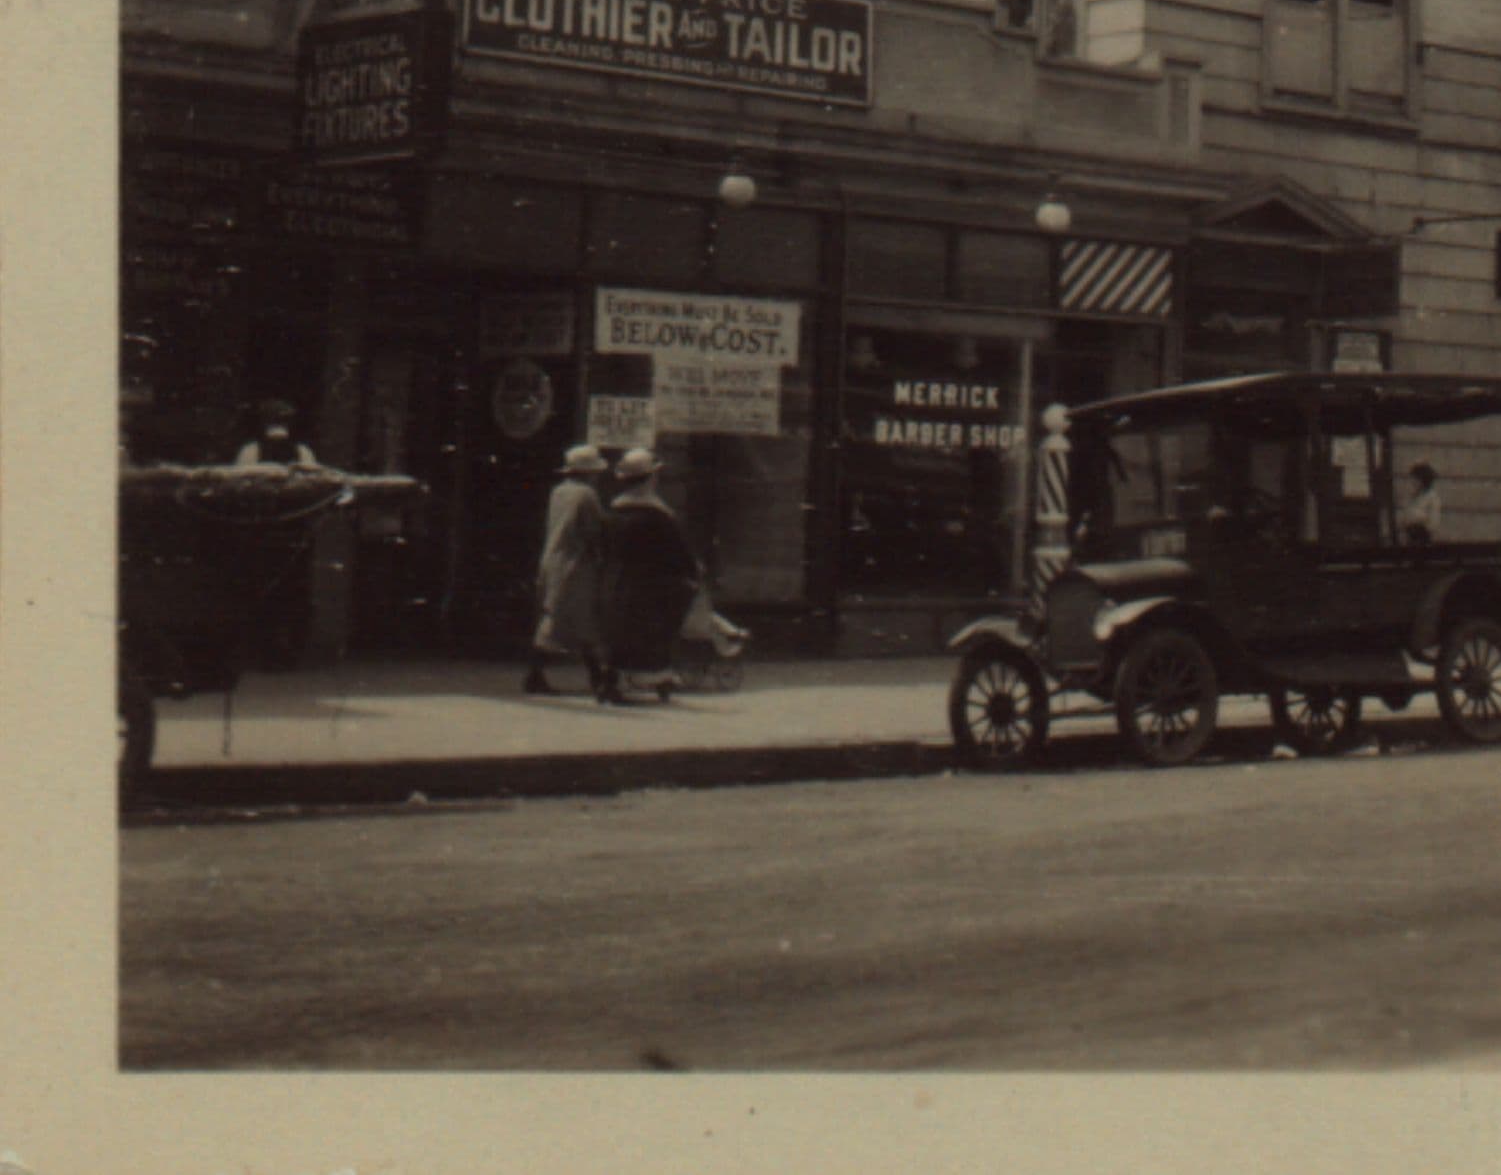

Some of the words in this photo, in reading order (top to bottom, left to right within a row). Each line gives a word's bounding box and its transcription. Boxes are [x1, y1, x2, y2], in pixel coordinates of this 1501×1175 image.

[677, 10, 717, 39] AND
[723, 13, 863, 75] TAILOR
[305, 57, 412, 106] LIGHTING
[302, 98, 410, 147] FIXTURES
[610, 316, 700, 347] BELOW
[711, 322, 788, 356] COST.
[744, 305, 784, 328] SOLD
[894, 380, 999, 409] MERRICK
[875, 418, 963, 447] BARBER
[969, 424, 1026, 449] SHOP
